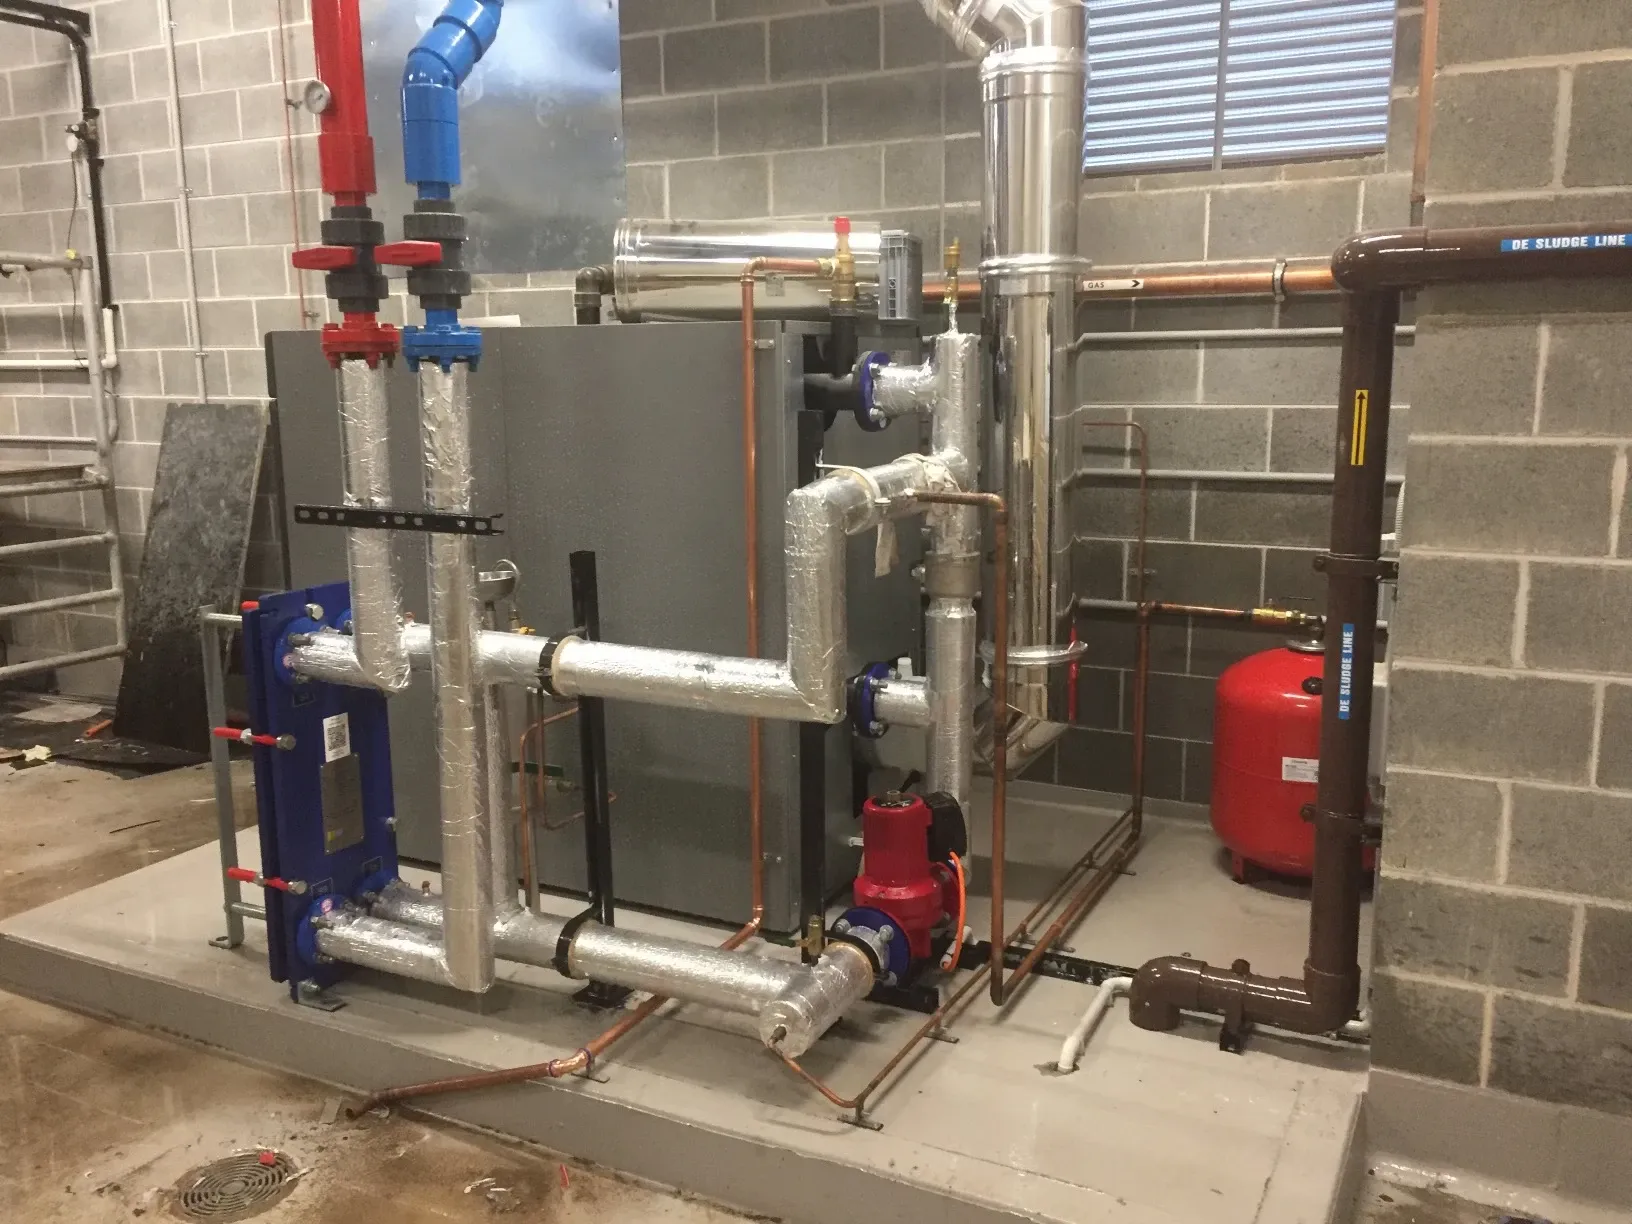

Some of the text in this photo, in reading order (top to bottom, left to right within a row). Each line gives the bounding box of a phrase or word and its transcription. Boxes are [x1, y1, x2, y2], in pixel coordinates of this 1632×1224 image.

[1512, 234, 1626, 250] DE SLUDGE LINE
[1087, 281, 1105, 289] GAS
[1339, 631, 1353, 712] DE SLUDGE LINE
